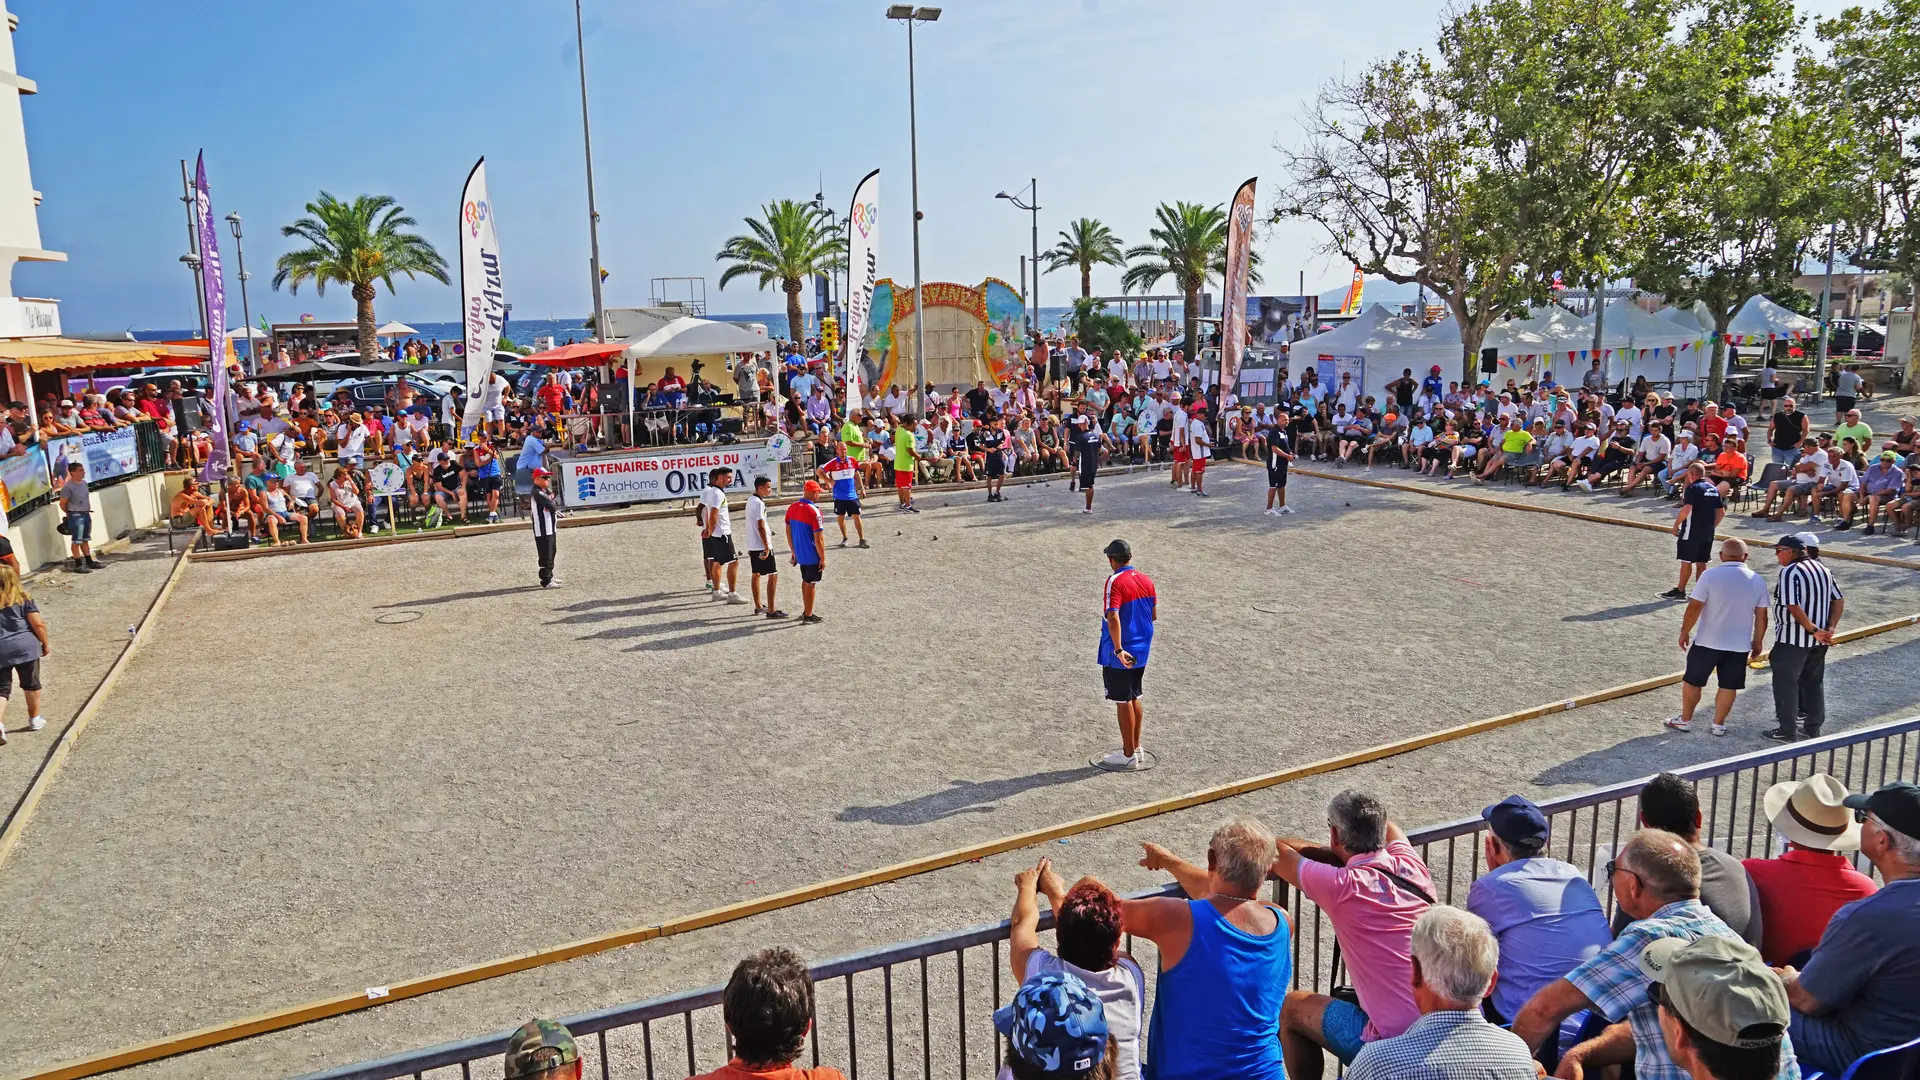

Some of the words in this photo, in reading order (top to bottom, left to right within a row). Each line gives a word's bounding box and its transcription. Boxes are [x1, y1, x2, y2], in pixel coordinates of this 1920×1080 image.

[468, 296, 486, 354] Fréjus
[849, 291, 862, 344] Fréjus
[82, 435, 100, 447] ECOLE
[575, 460, 659, 477] PARTENAIRES
[661, 455, 720, 471] OFFICIELS
[723, 453, 739, 465] DU
[599, 479, 659, 493] AnaHome
[1645, 950, 1662, 972] MONACO
[1740, 1036, 1778, 1049] MONACO
